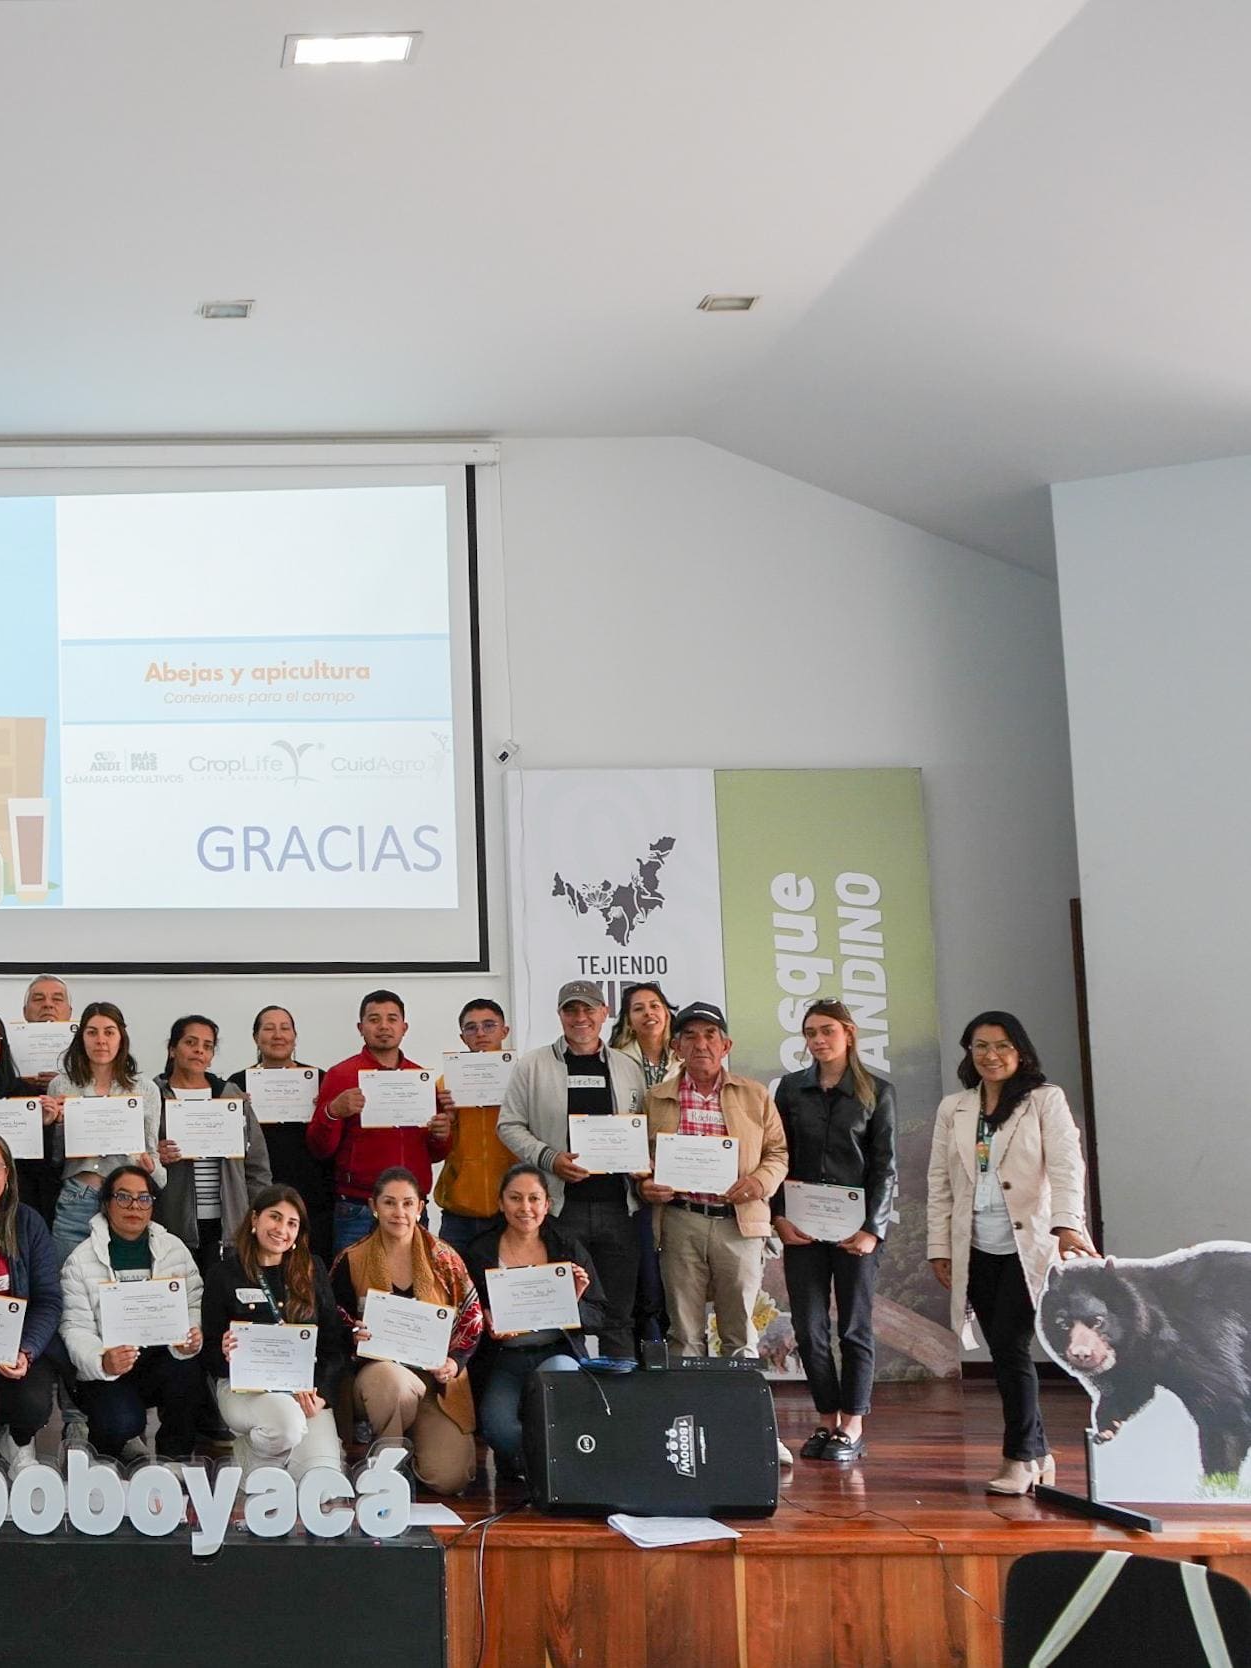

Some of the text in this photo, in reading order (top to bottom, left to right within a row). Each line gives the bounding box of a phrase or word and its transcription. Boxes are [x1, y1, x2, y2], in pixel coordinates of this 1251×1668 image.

[144, 659, 371, 687] Abejas y apicultura
[163, 689, 356, 706] Conexiones para el campo
[90, 762, 122, 771] ANDI
[189, 755, 283, 776] CropLife
[331, 756, 426, 774] CuidAgro
[112, 774, 184, 784] PROCULTIVOS
[197, 824, 442, 874] GRACIAS
[577, 955, 668, 975] TEJIENDO
[834, 872, 891, 1073] ANDINO
[767, 872, 834, 1102] osque
[678, 1420, 691, 1473] 18000W
